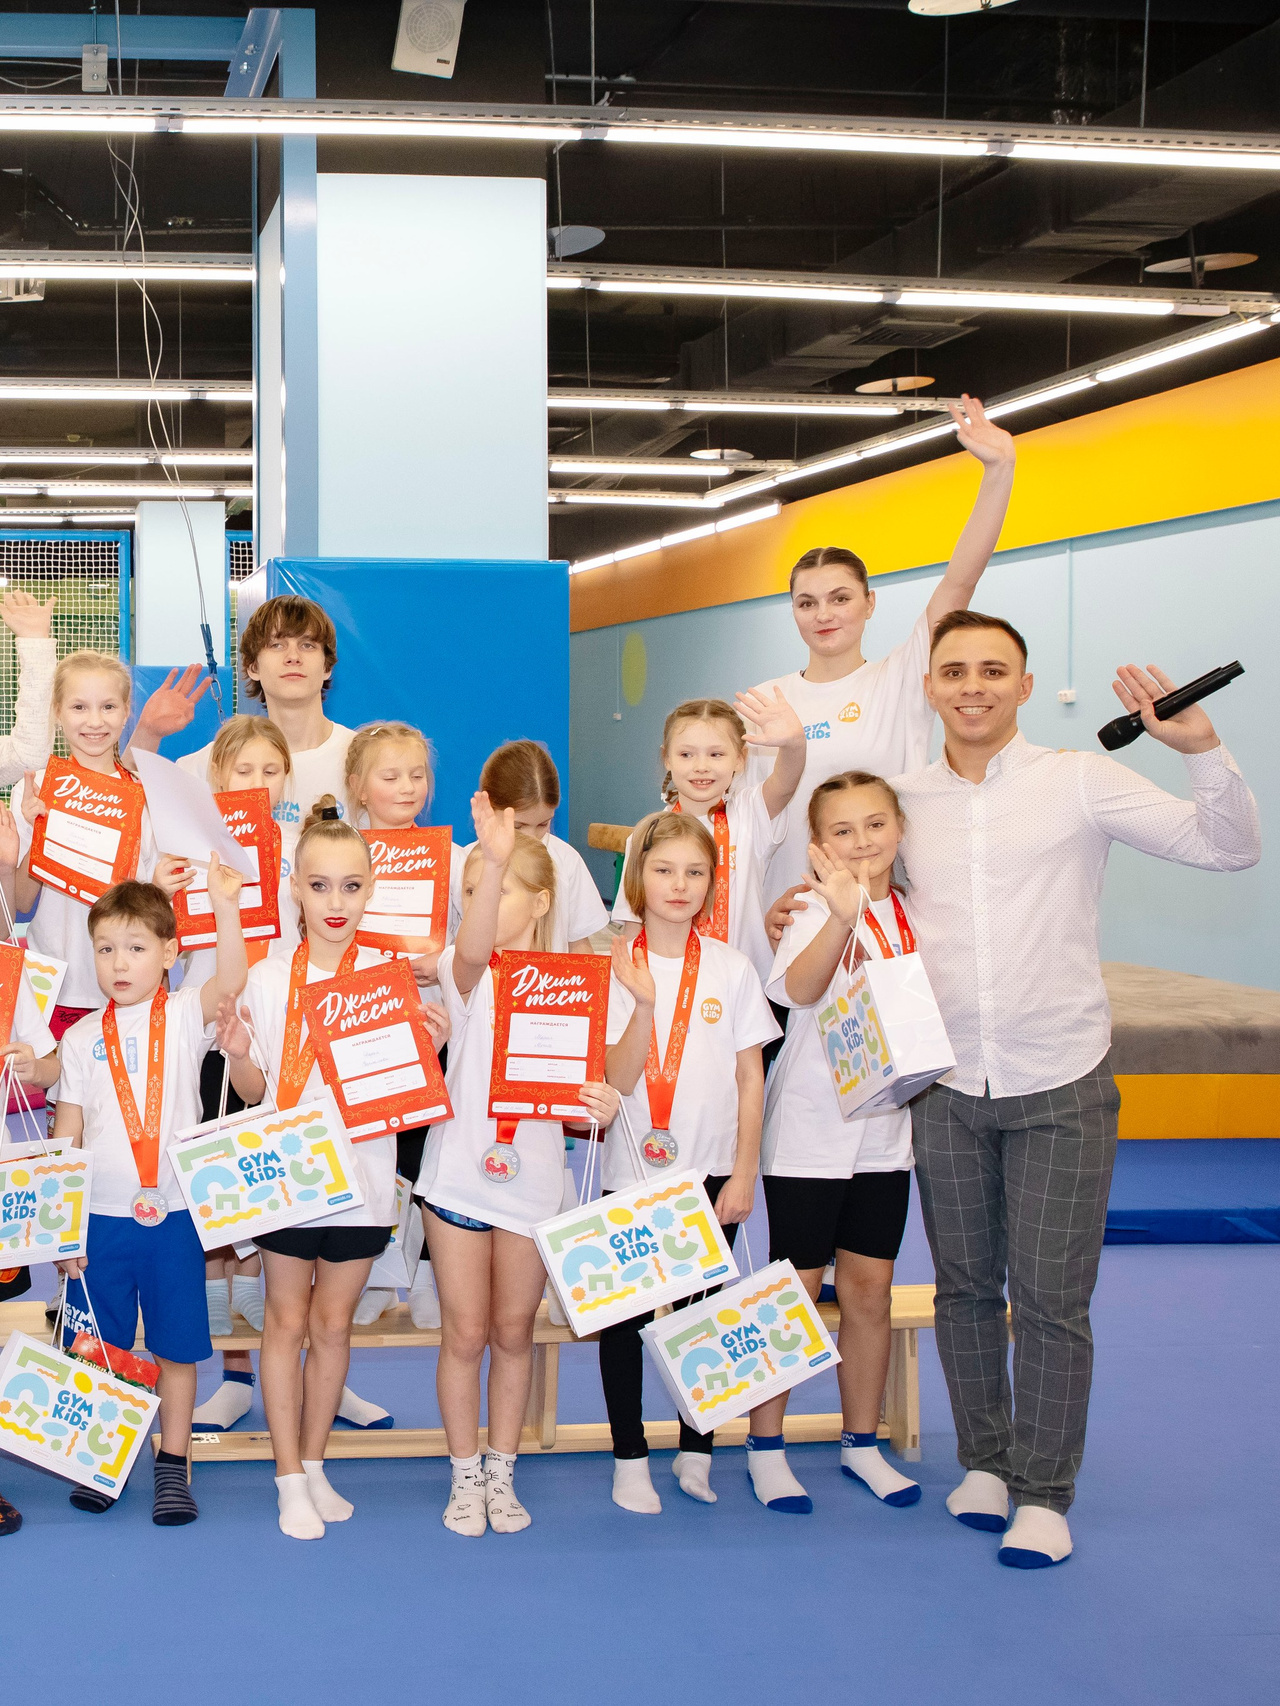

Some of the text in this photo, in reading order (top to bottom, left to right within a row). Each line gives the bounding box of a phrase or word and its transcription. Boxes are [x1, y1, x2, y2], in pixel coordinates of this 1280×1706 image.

[64, 798, 127, 820] тест
[221, 809, 248, 824] им
[227, 822, 257, 838] ст
[374, 857, 437, 876] тест
[525, 989, 594, 1008] тест
[702, 1003, 721, 1012] GYM
[339, 997, 404, 1032] тест
[841, 1015, 860, 1038] GYM
[94, 1041, 106, 1052] GY
[351, 1033, 391, 1047] НАГРАЖДАЕТСЯ
[846, 1032, 864, 1053] KiDs
[95, 1049, 107, 1059] Ki
[237, 1149, 282, 1172] GYM
[243, 1166, 287, 1188] KiDs
[2, 1190, 37, 1208] GYM
[2, 1205, 37, 1223] KiDs
[609, 1224, 654, 1250] GYM
[615, 1241, 660, 1266] KiDs
[64, 1302, 93, 1324] GYM
[720, 1322, 762, 1349] GYM
[727, 1337, 767, 1363] KiDs
[57, 1390, 94, 1418] GYM
[51, 1403, 89, 1432] KiDs
[841, 1433, 855, 1441] YM
